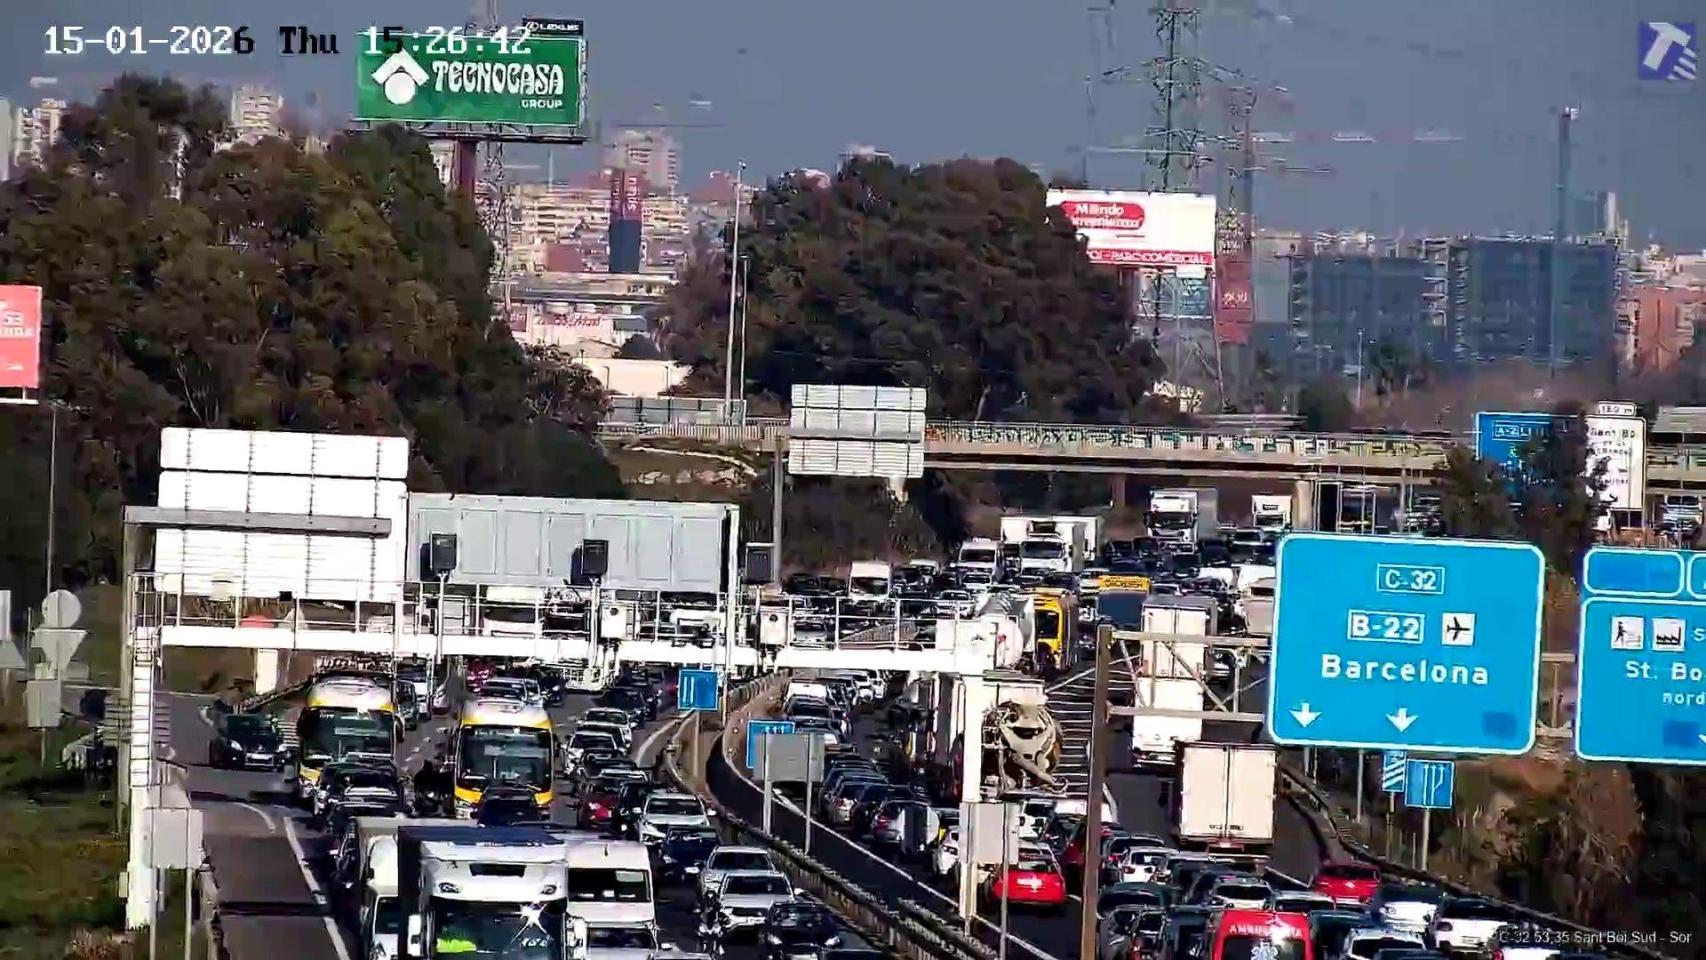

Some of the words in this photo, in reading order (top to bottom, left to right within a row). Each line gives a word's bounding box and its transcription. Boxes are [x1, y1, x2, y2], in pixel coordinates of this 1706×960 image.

[432, 60, 564, 96] TECNOCASA
[521, 99, 563, 109] GROUP
[1385, 568, 1437, 591] C-32
[1351, 613, 1420, 640] B-22
[1321, 653, 1489, 685] Barcelona
[1625, 660, 1658, 680] St.
